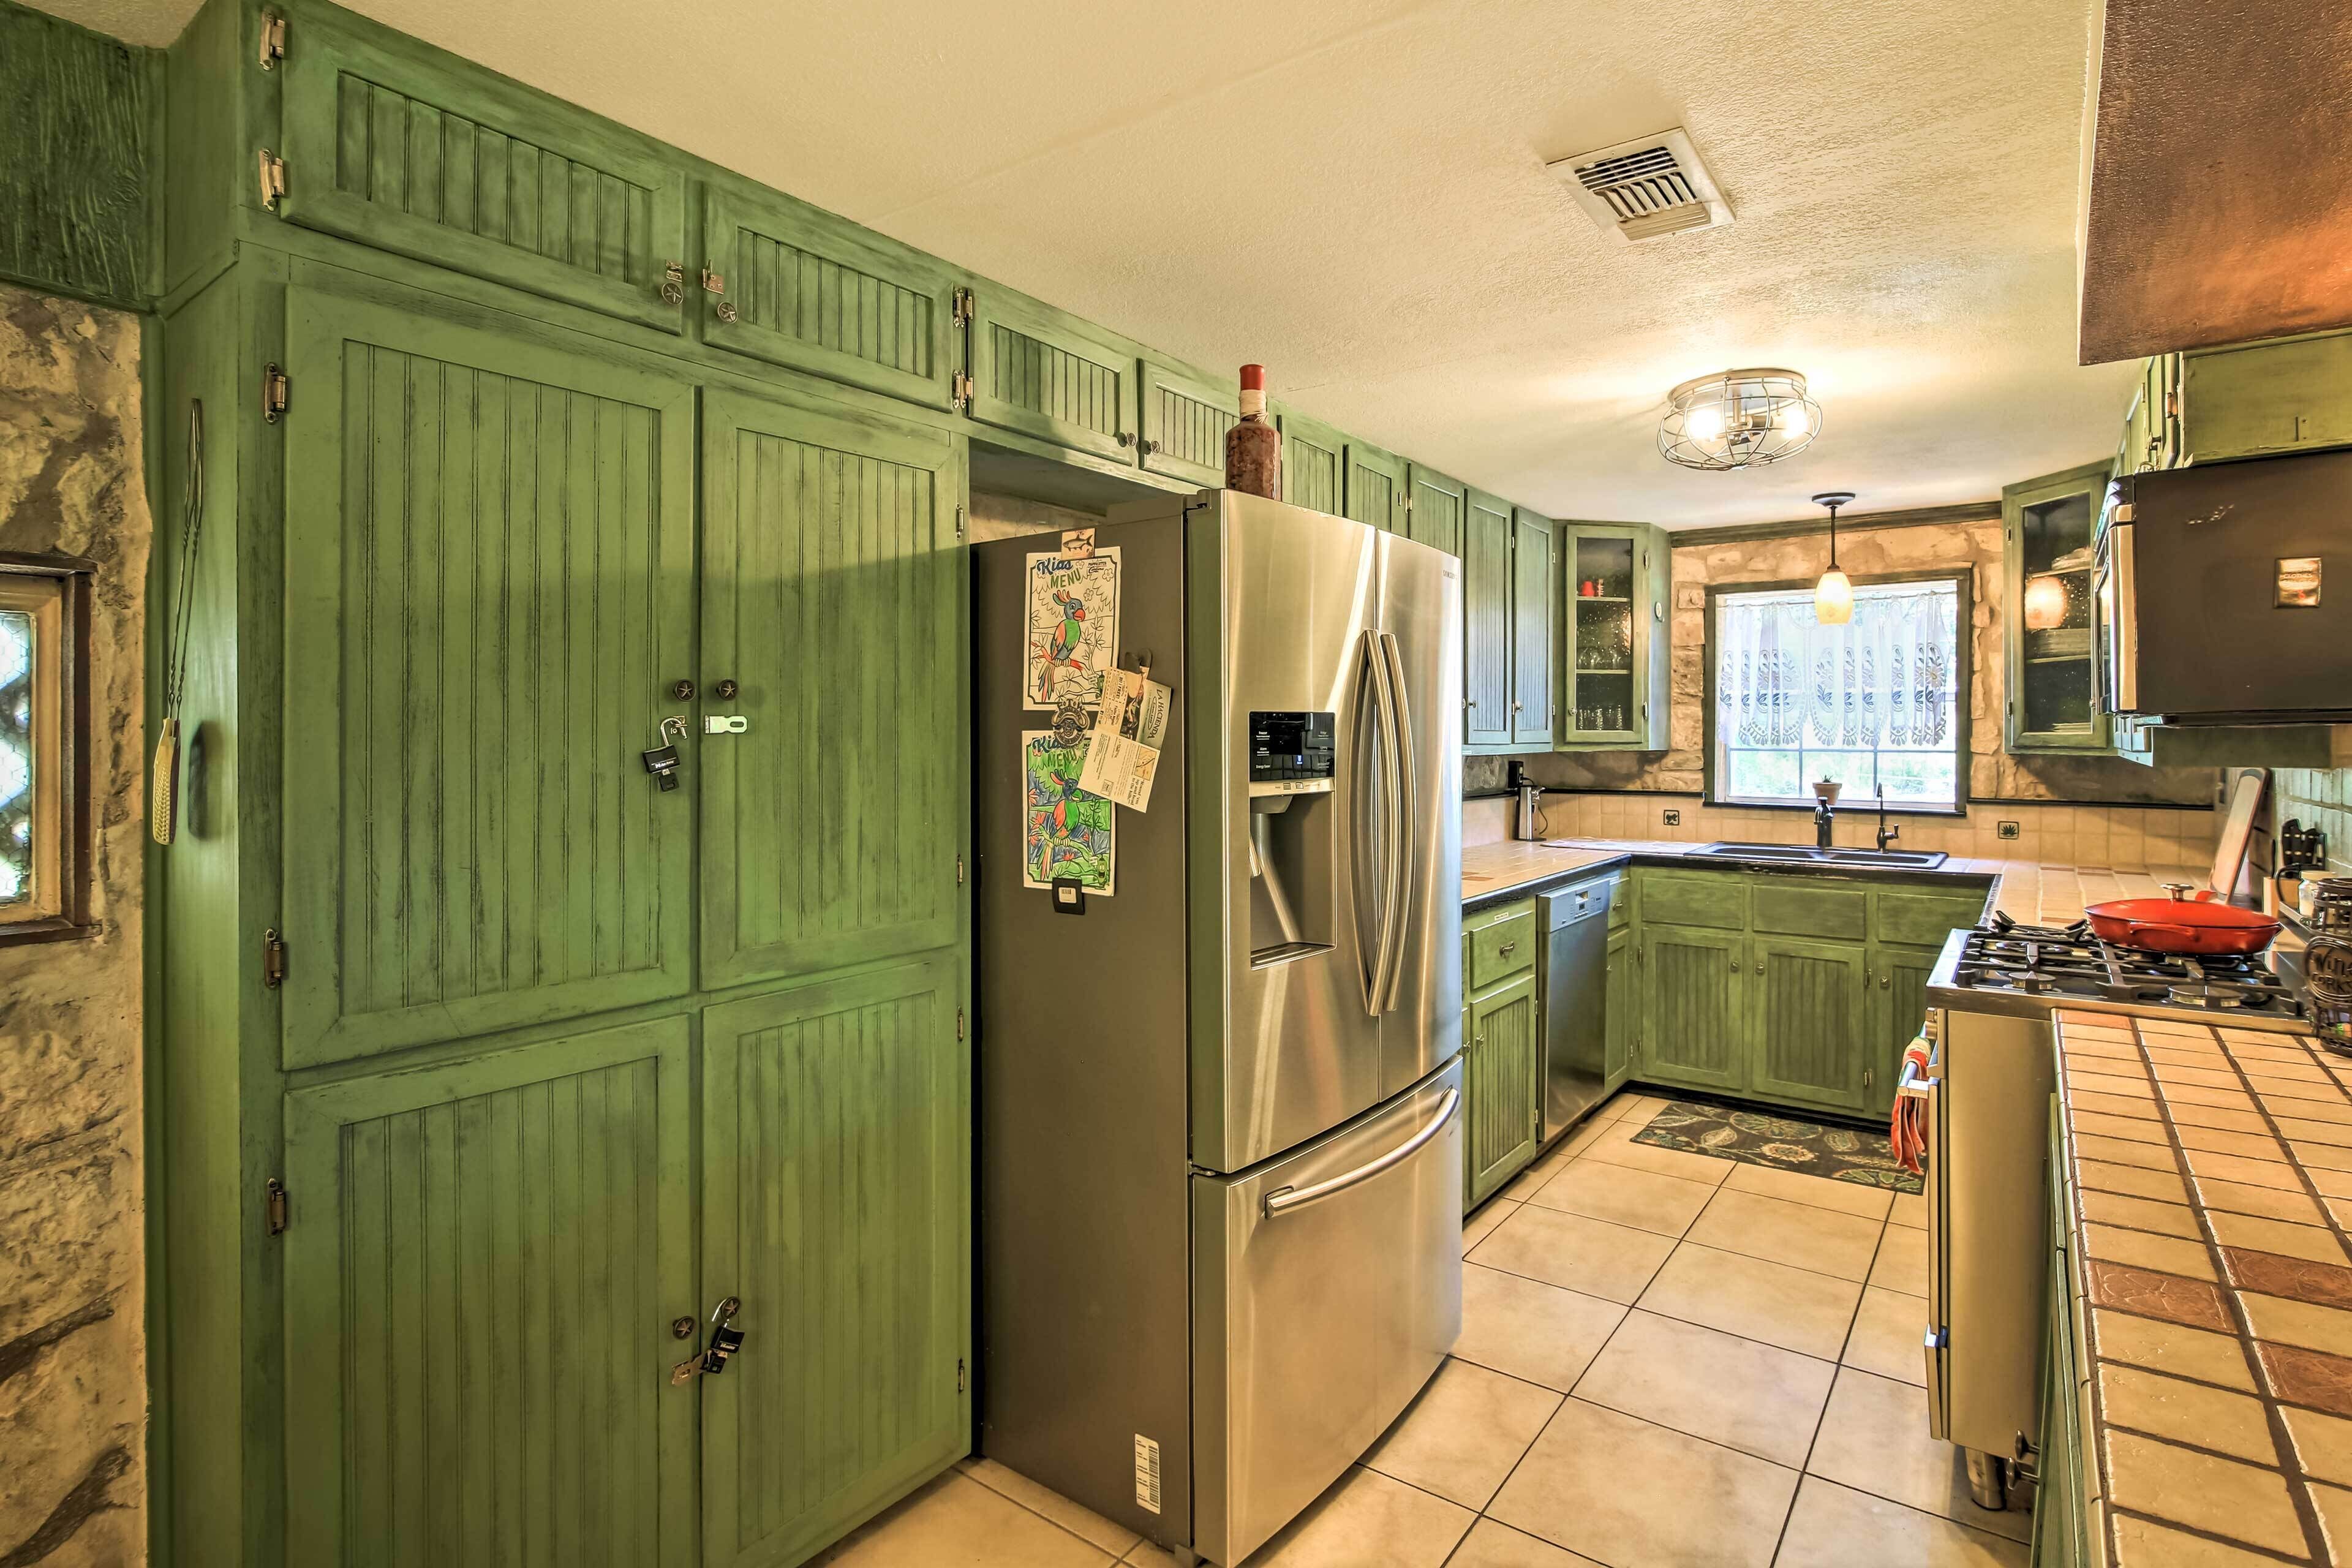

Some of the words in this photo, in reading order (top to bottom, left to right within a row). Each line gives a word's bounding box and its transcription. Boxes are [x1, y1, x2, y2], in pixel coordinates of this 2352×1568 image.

[1050, 568, 1081, 589] MENU
[1156, 689, 1163, 699] LA
[1147, 701, 1164, 739] HACIENDA
[1047, 748, 1077, 767] MENU
